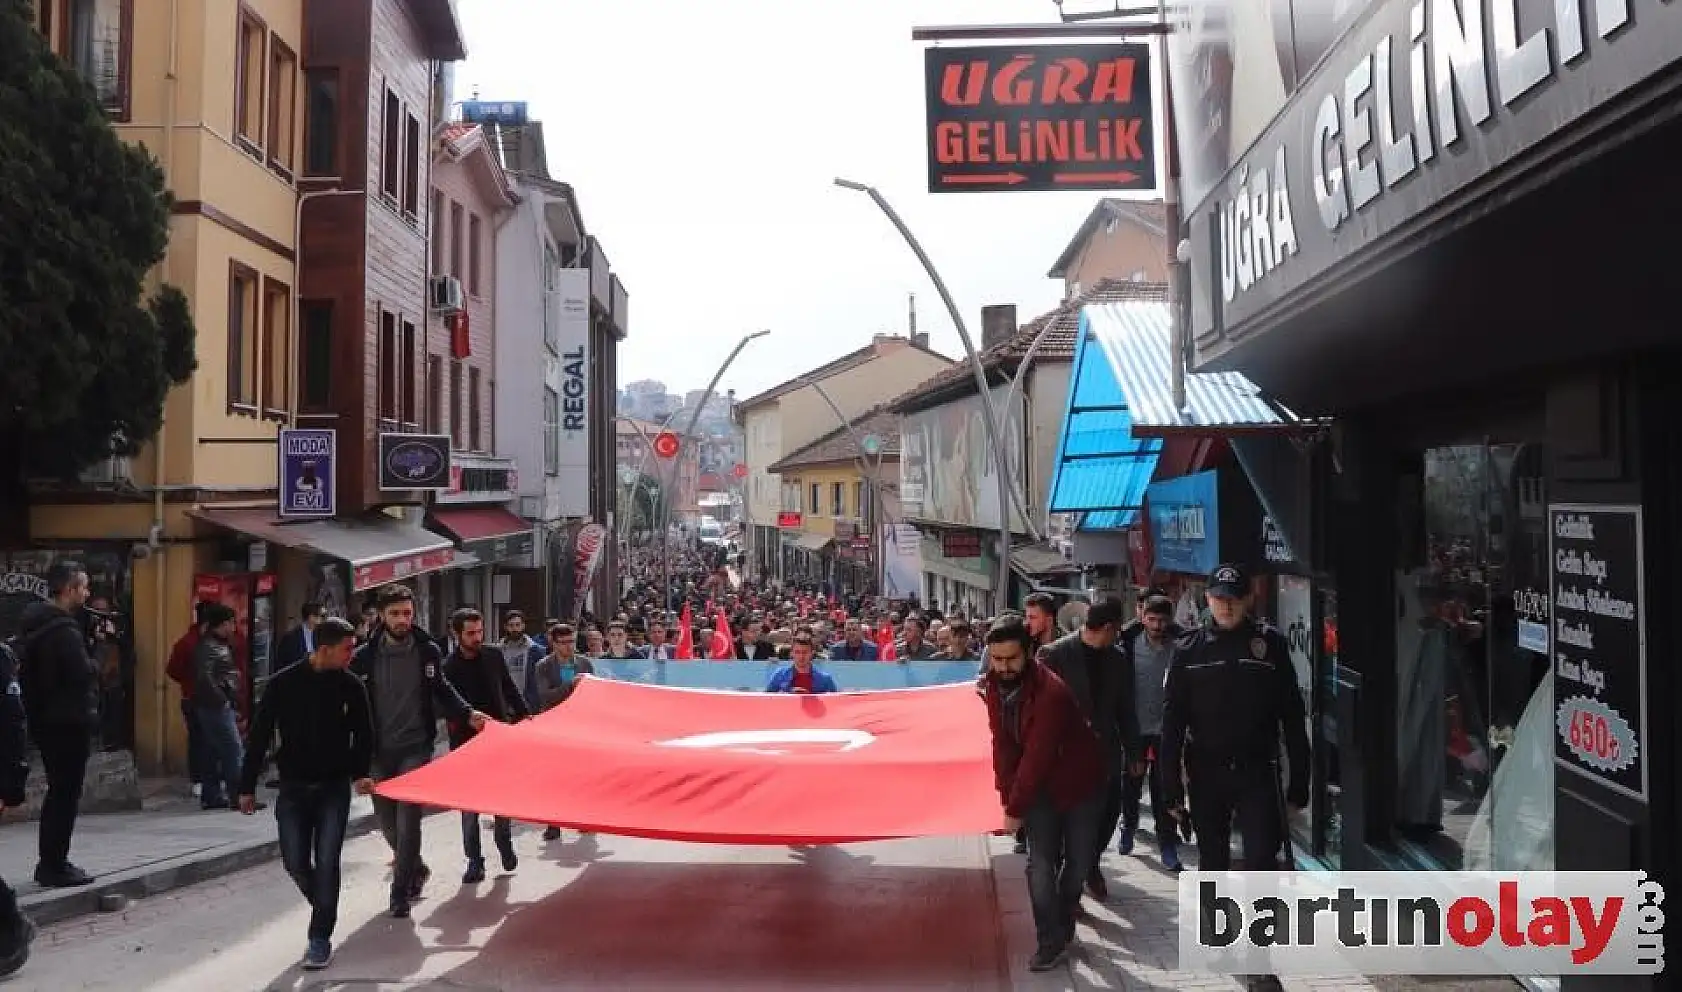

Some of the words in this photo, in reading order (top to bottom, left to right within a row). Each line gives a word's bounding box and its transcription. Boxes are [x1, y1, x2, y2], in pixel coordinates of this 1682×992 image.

[942, 53, 1136, 106] UĞRA
[1220, 142, 1298, 303] UĞRA
[563, 345, 584, 430] REGAL
[288, 437, 329, 455] MODA
